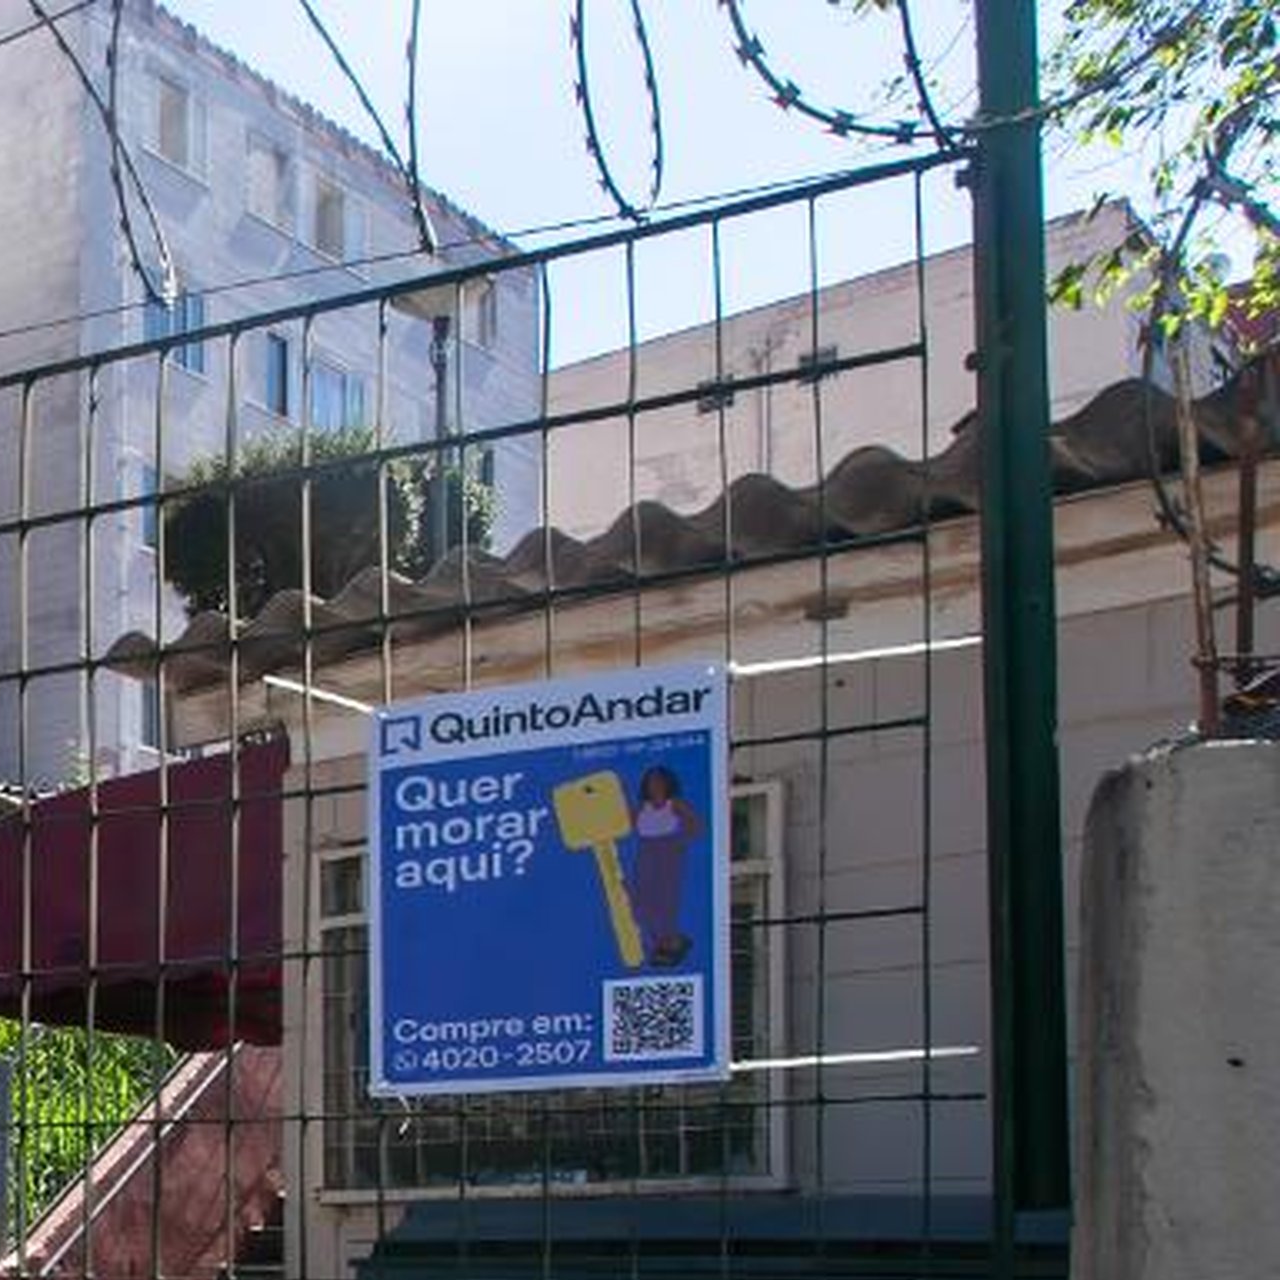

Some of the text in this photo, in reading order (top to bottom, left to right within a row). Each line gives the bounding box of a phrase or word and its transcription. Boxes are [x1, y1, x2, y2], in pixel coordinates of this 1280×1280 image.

[429, 685, 713, 745] QuintoAndar
[395, 772, 524, 812] Quer
[395, 807, 550, 851] morar
[395, 839, 535, 893] aqui?
[393, 1013, 594, 1044] Compre em:
[422, 1038, 592, 1072] 4020-2507
